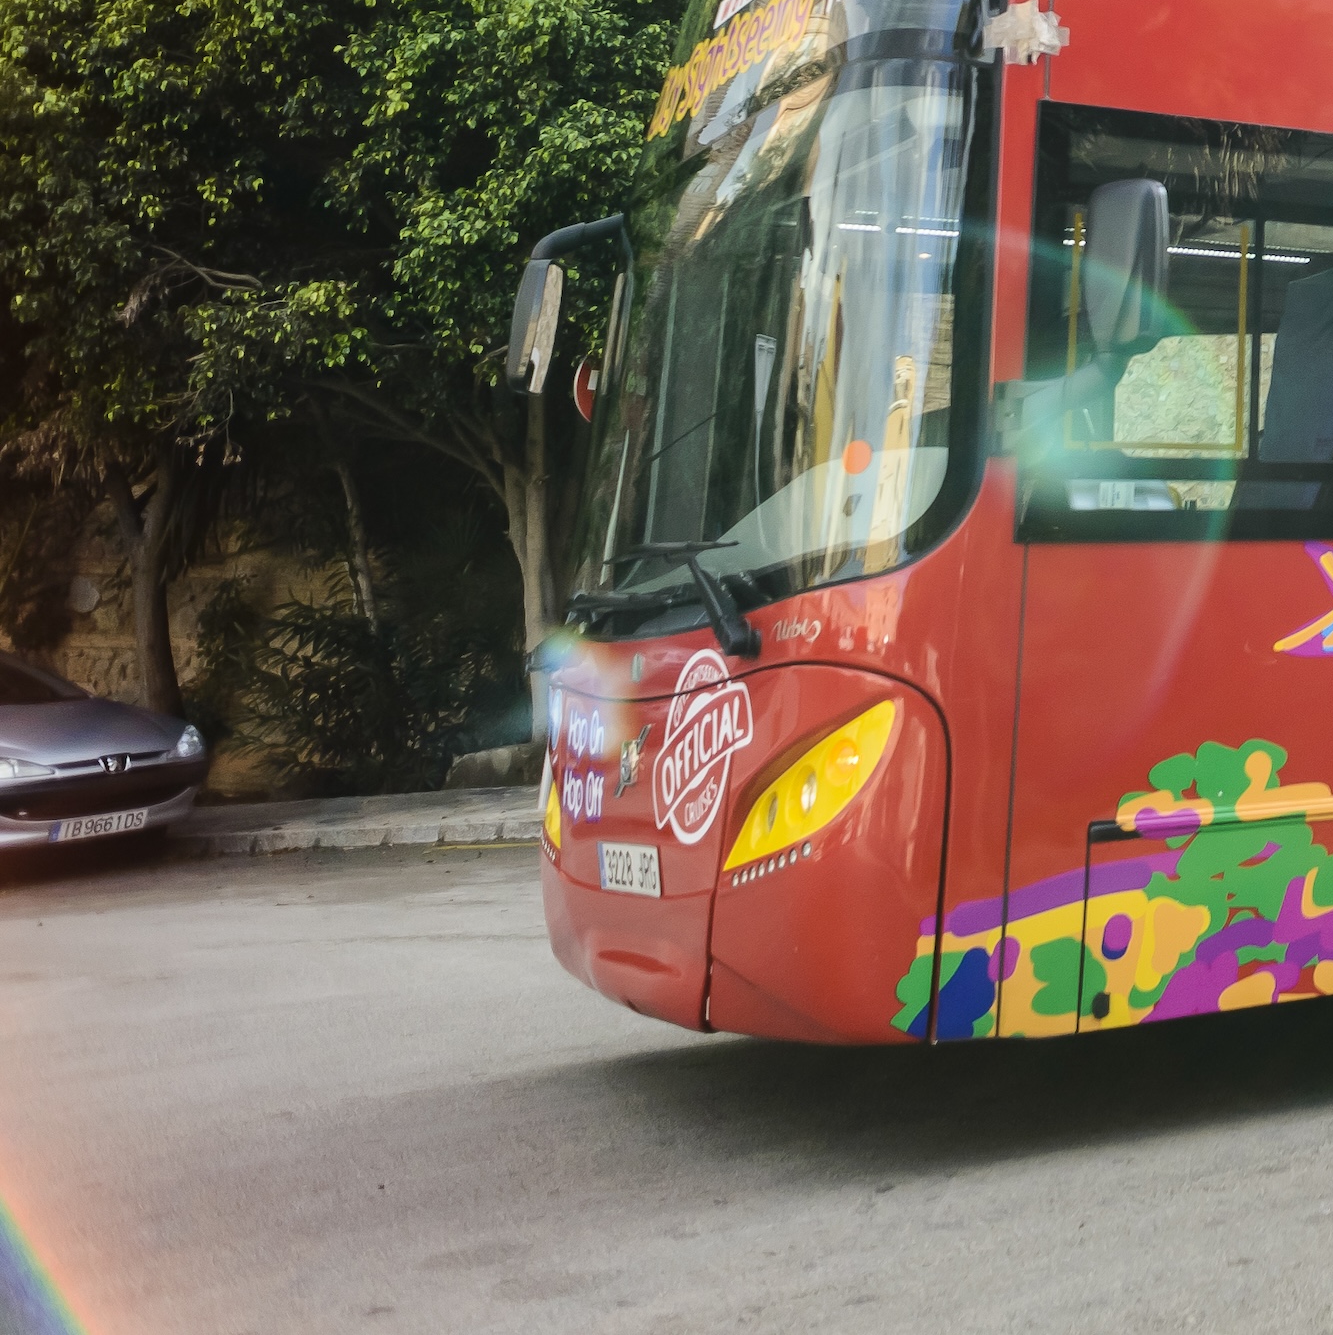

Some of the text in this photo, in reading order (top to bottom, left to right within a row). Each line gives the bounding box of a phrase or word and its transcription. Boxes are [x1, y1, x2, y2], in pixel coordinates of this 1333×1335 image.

[567, 708, 605, 759] Hop On
[661, 694, 746, 807] OFFICIAL
[562, 769, 605, 820] Hop Off
